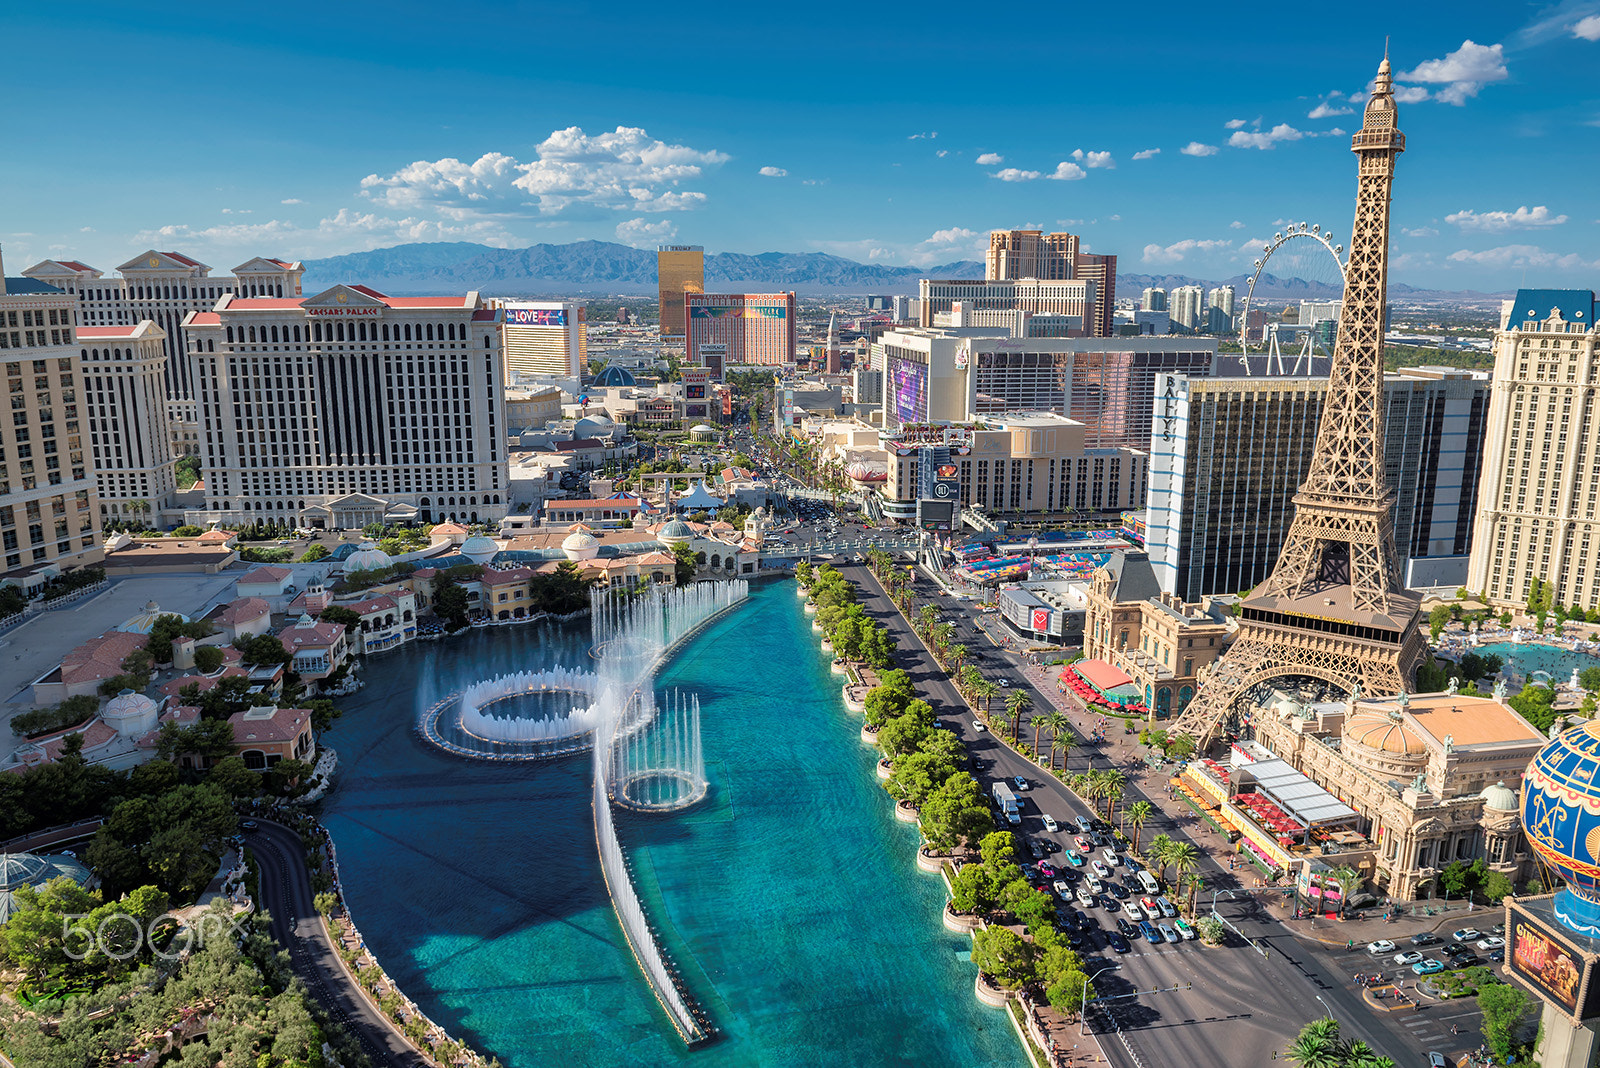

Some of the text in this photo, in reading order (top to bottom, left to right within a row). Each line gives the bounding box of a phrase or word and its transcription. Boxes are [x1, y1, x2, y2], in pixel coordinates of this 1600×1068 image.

[308, 308, 344, 316] CAESARS
[515, 310, 539, 323] LOVE
[1516, 923, 1549, 954] CIRCUS
